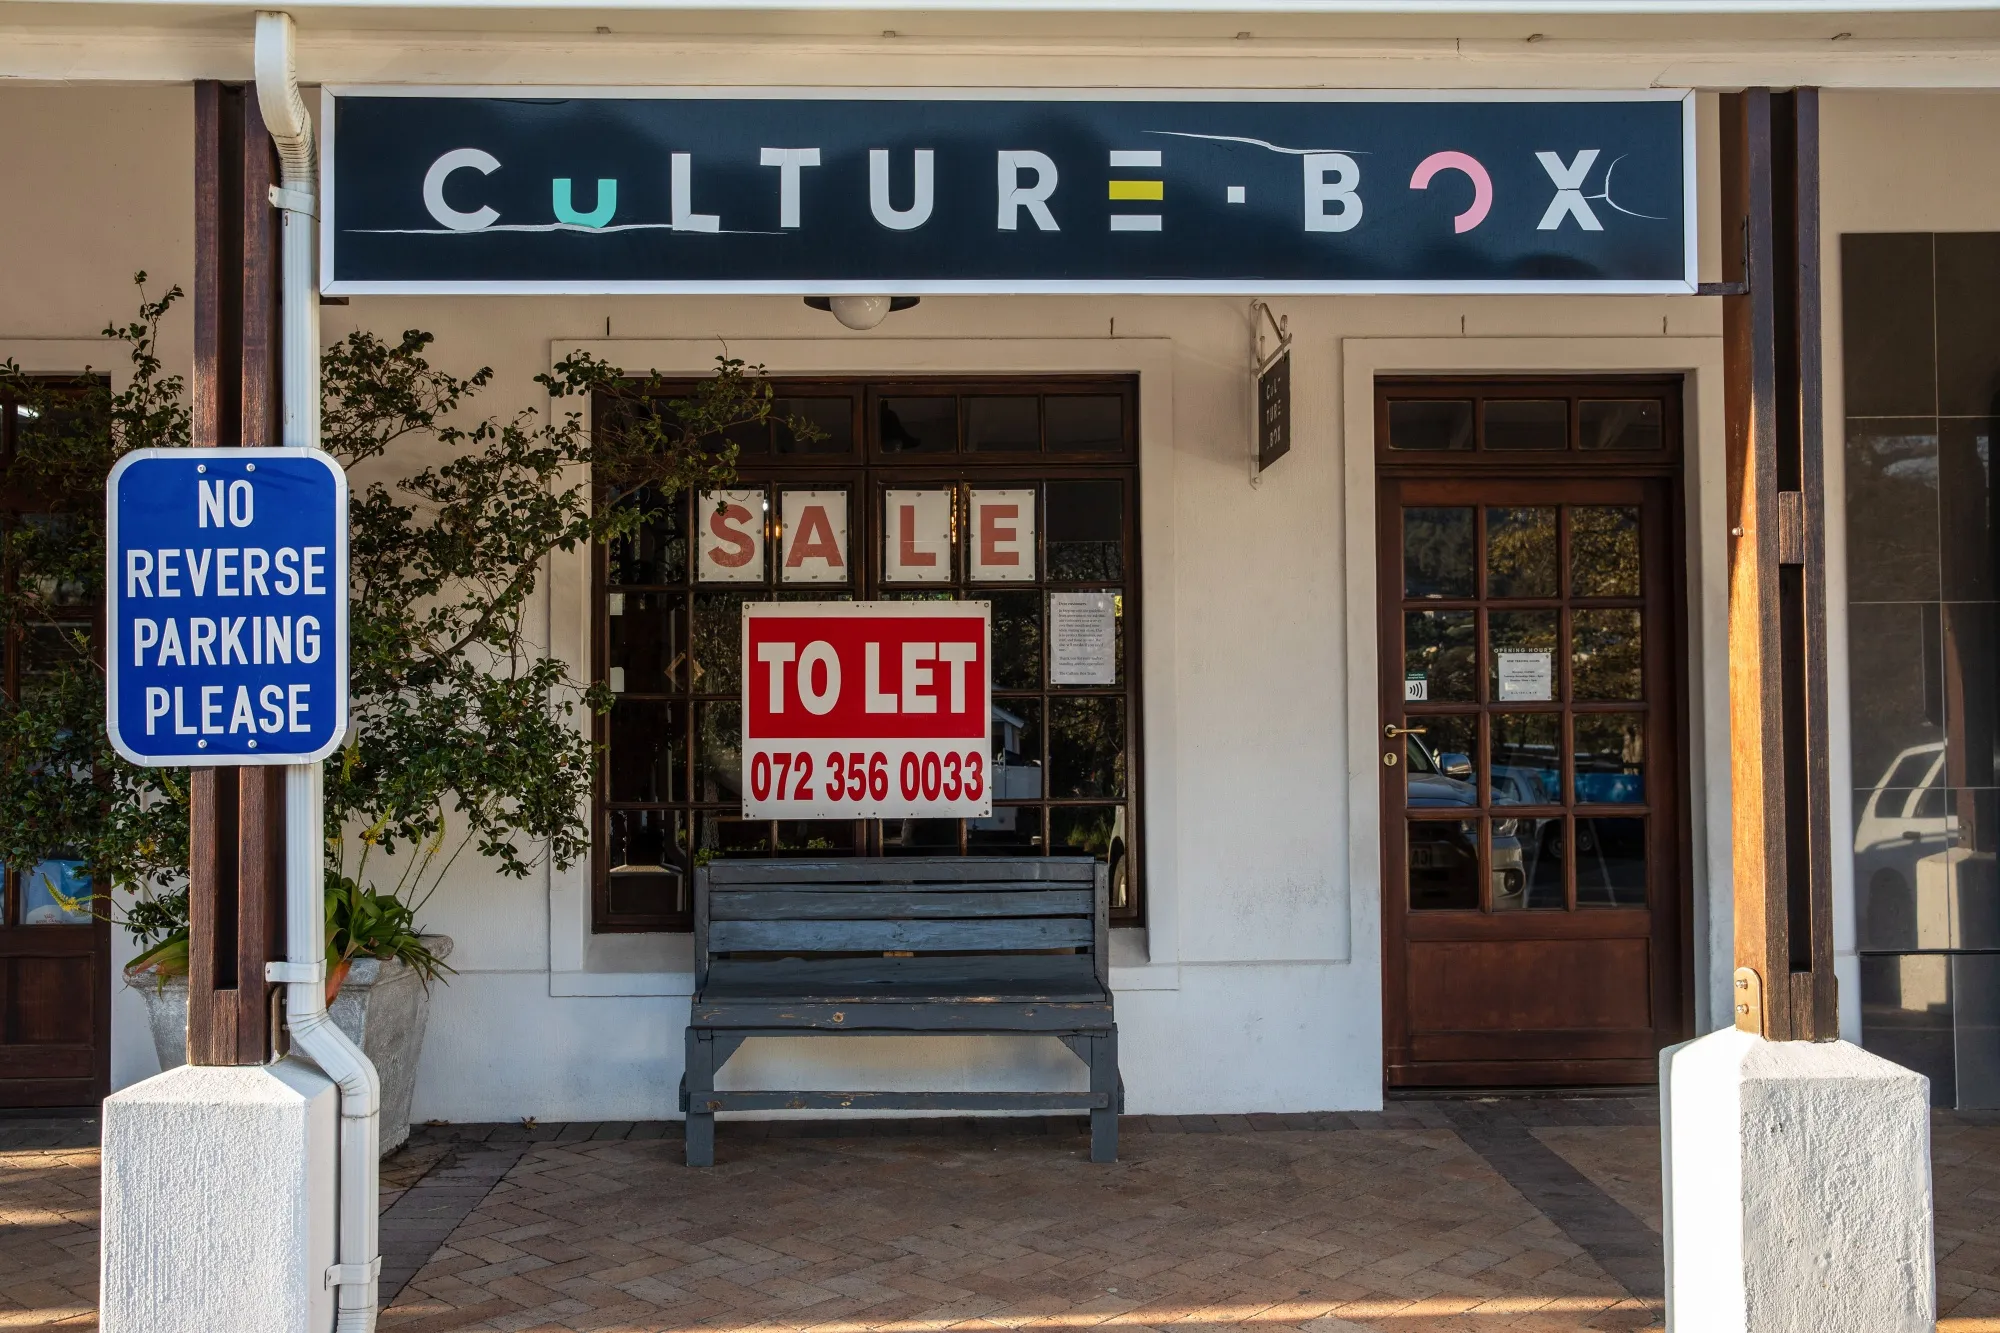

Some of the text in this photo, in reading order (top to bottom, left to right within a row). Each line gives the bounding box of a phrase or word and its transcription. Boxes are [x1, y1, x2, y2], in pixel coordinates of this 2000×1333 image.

[1302, 148, 1604, 234] BOX
[198, 479, 254, 529] NO
[707, 503, 1020, 568] SALE
[127, 546, 327, 598] REVERSE
[134, 615, 321, 667] PARKING
[757, 641, 977, 716] TO LET
[146, 683, 311, 736] PLEASE
[750, 751, 984, 802] 072 356 0033
